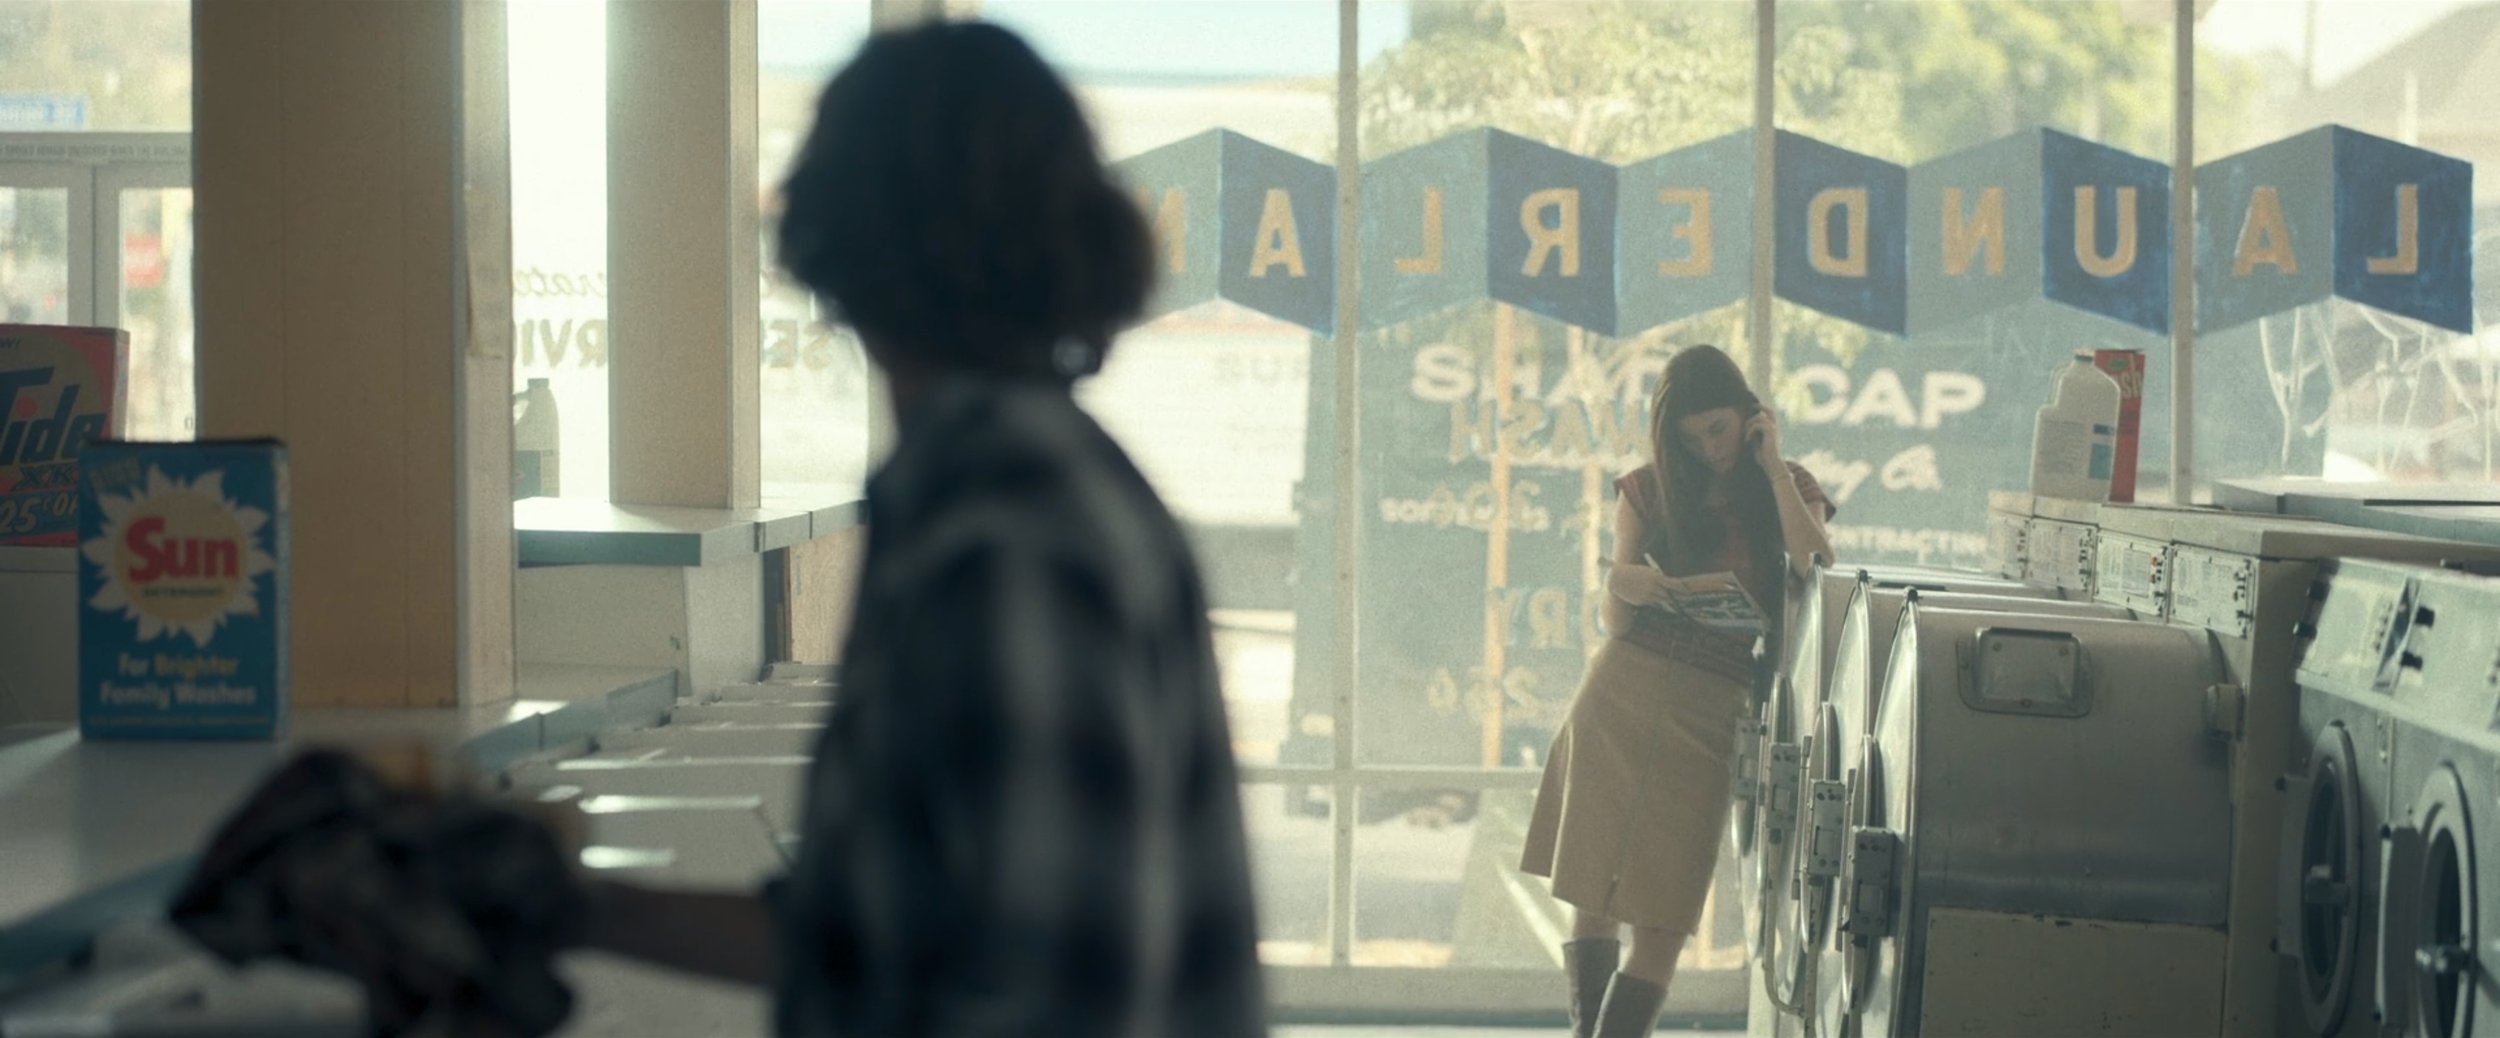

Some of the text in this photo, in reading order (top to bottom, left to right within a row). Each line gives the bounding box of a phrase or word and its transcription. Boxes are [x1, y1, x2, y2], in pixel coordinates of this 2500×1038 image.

[0, 366, 107, 467] Tide
[1782, 363, 1987, 430] CAP
[125, 516, 240, 583] Sun
[99, 680, 257, 711] Family Washes
[118, 652, 241, 686] For Brighter
